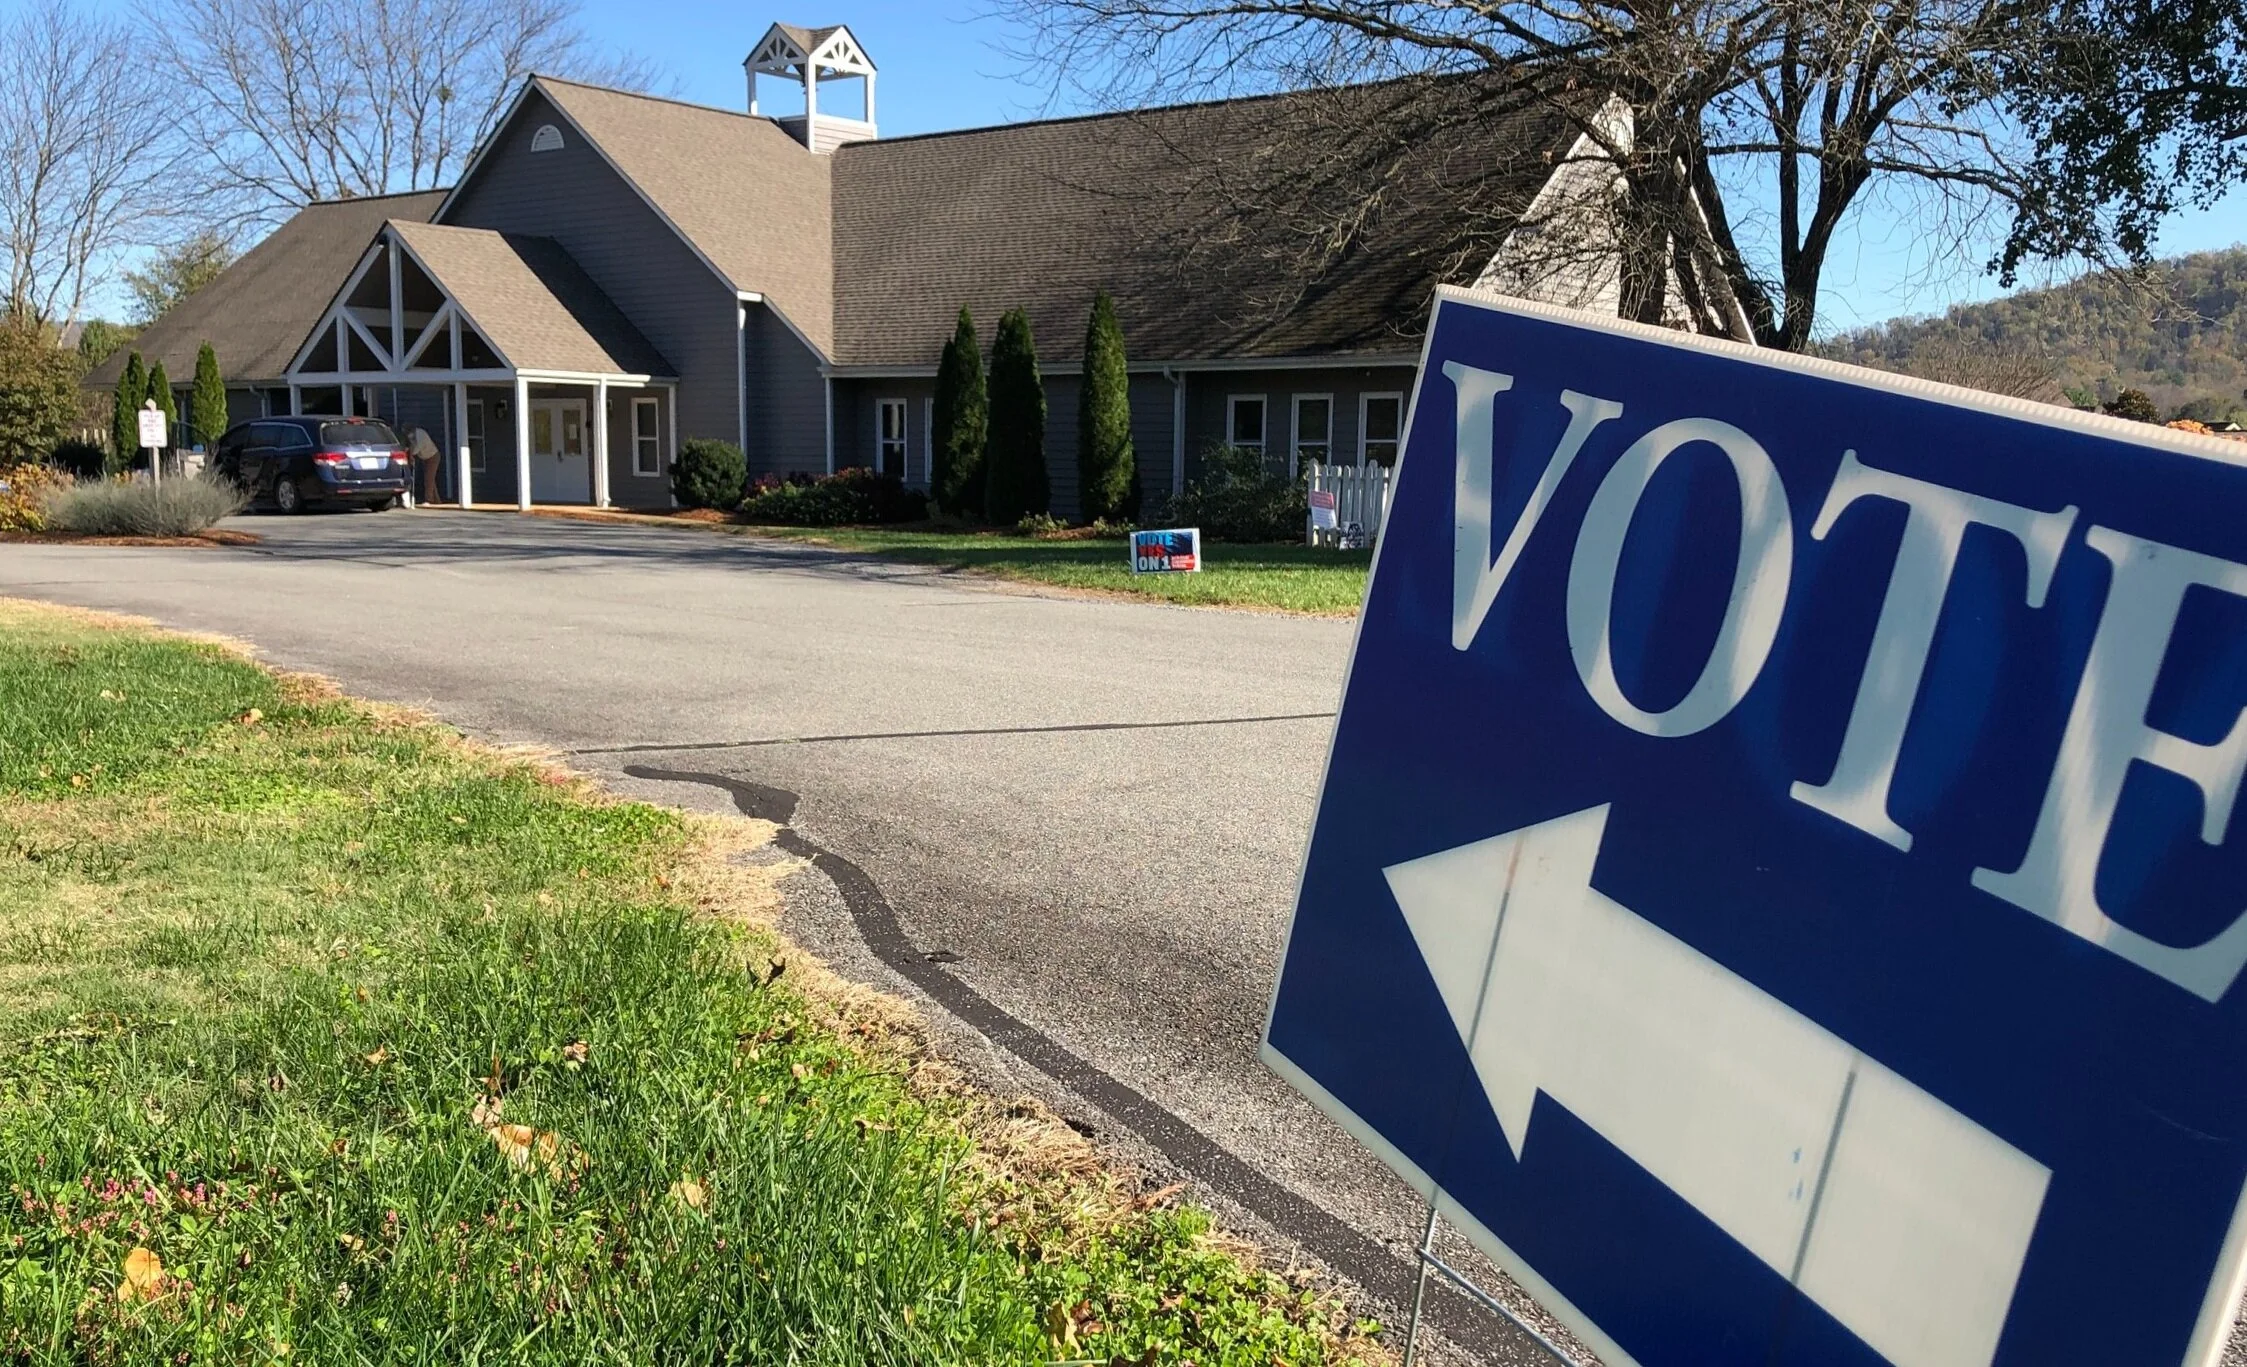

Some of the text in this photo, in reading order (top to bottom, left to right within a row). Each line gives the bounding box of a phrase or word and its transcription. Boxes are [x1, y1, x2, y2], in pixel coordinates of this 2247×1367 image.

[1138, 532, 1174, 545] VOTE
[1138, 556, 1160, 570] ON
[1161, 555, 1171, 569] 1
[1442, 360, 2247, 1003] VOTE
